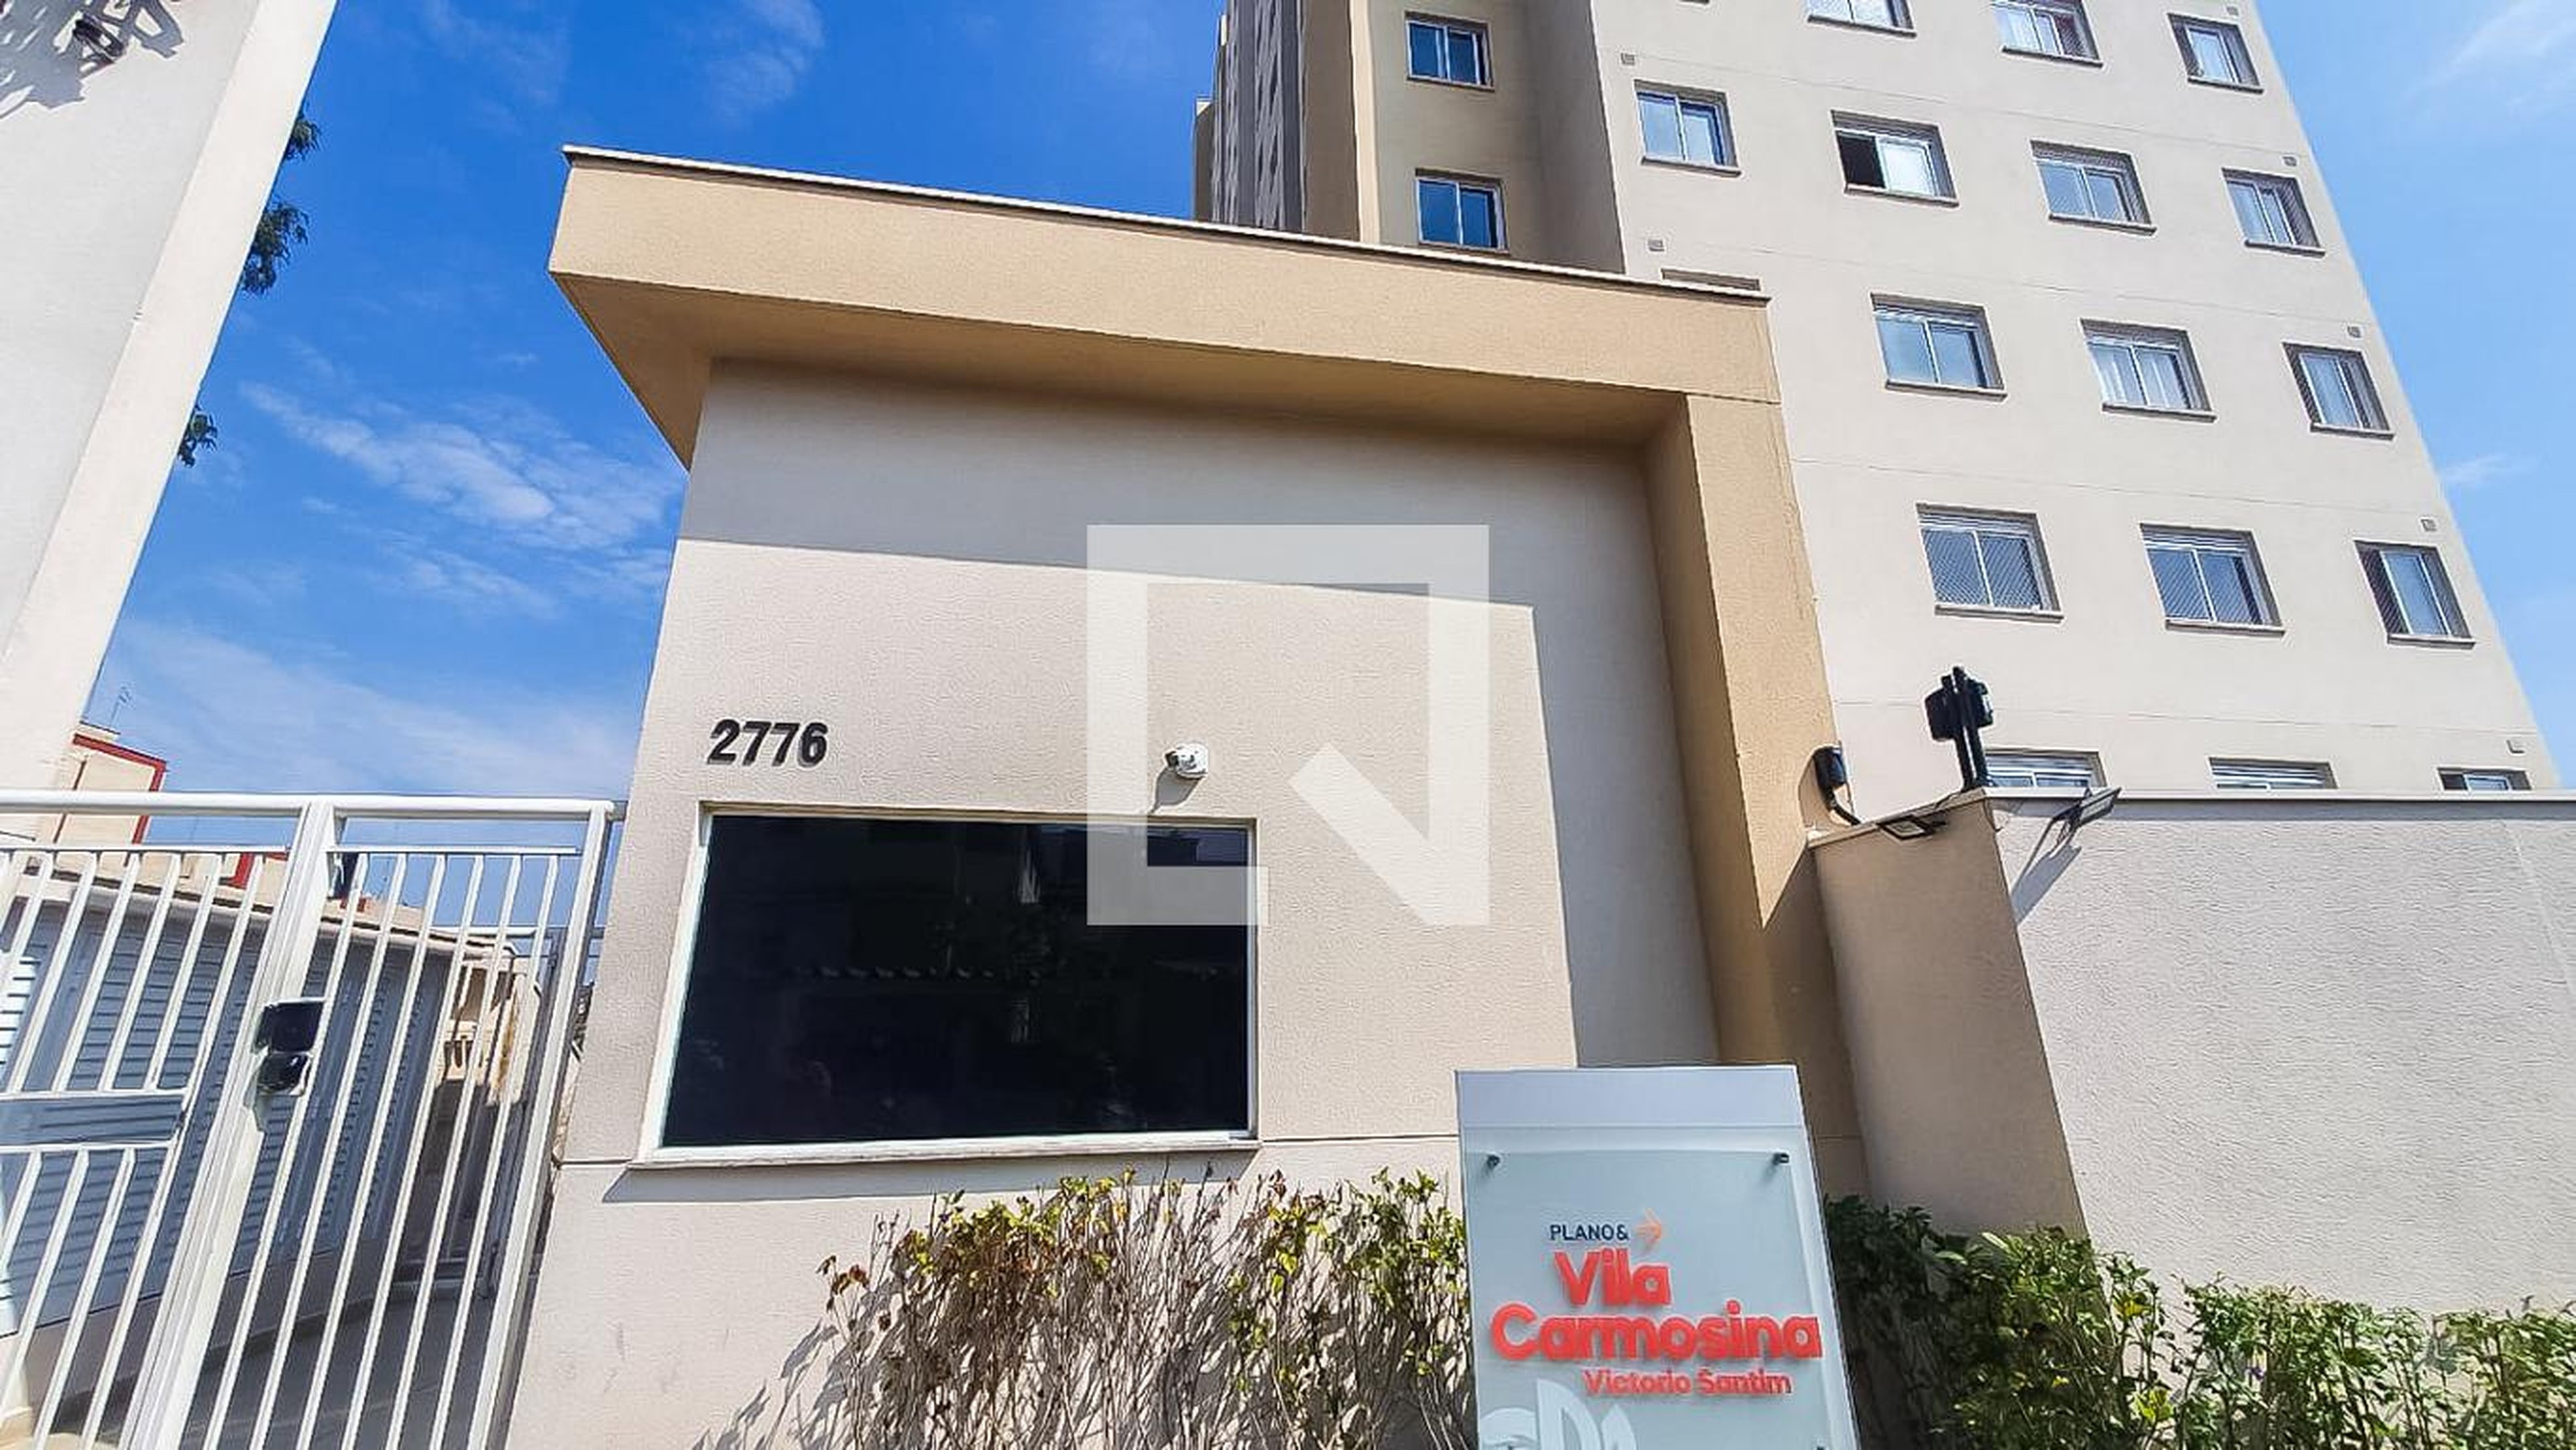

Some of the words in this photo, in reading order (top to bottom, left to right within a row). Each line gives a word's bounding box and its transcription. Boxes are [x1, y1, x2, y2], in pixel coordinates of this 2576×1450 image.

[706, 719, 828, 768] 2776
[1550, 1224, 1629, 1241] PLANO&
[1554, 1247, 1672, 1306] Vila
[1490, 1300, 1823, 1360] Carmosina
[1583, 1369, 1691, 1394] Victorio
[1697, 1367, 1792, 1394] Santim
